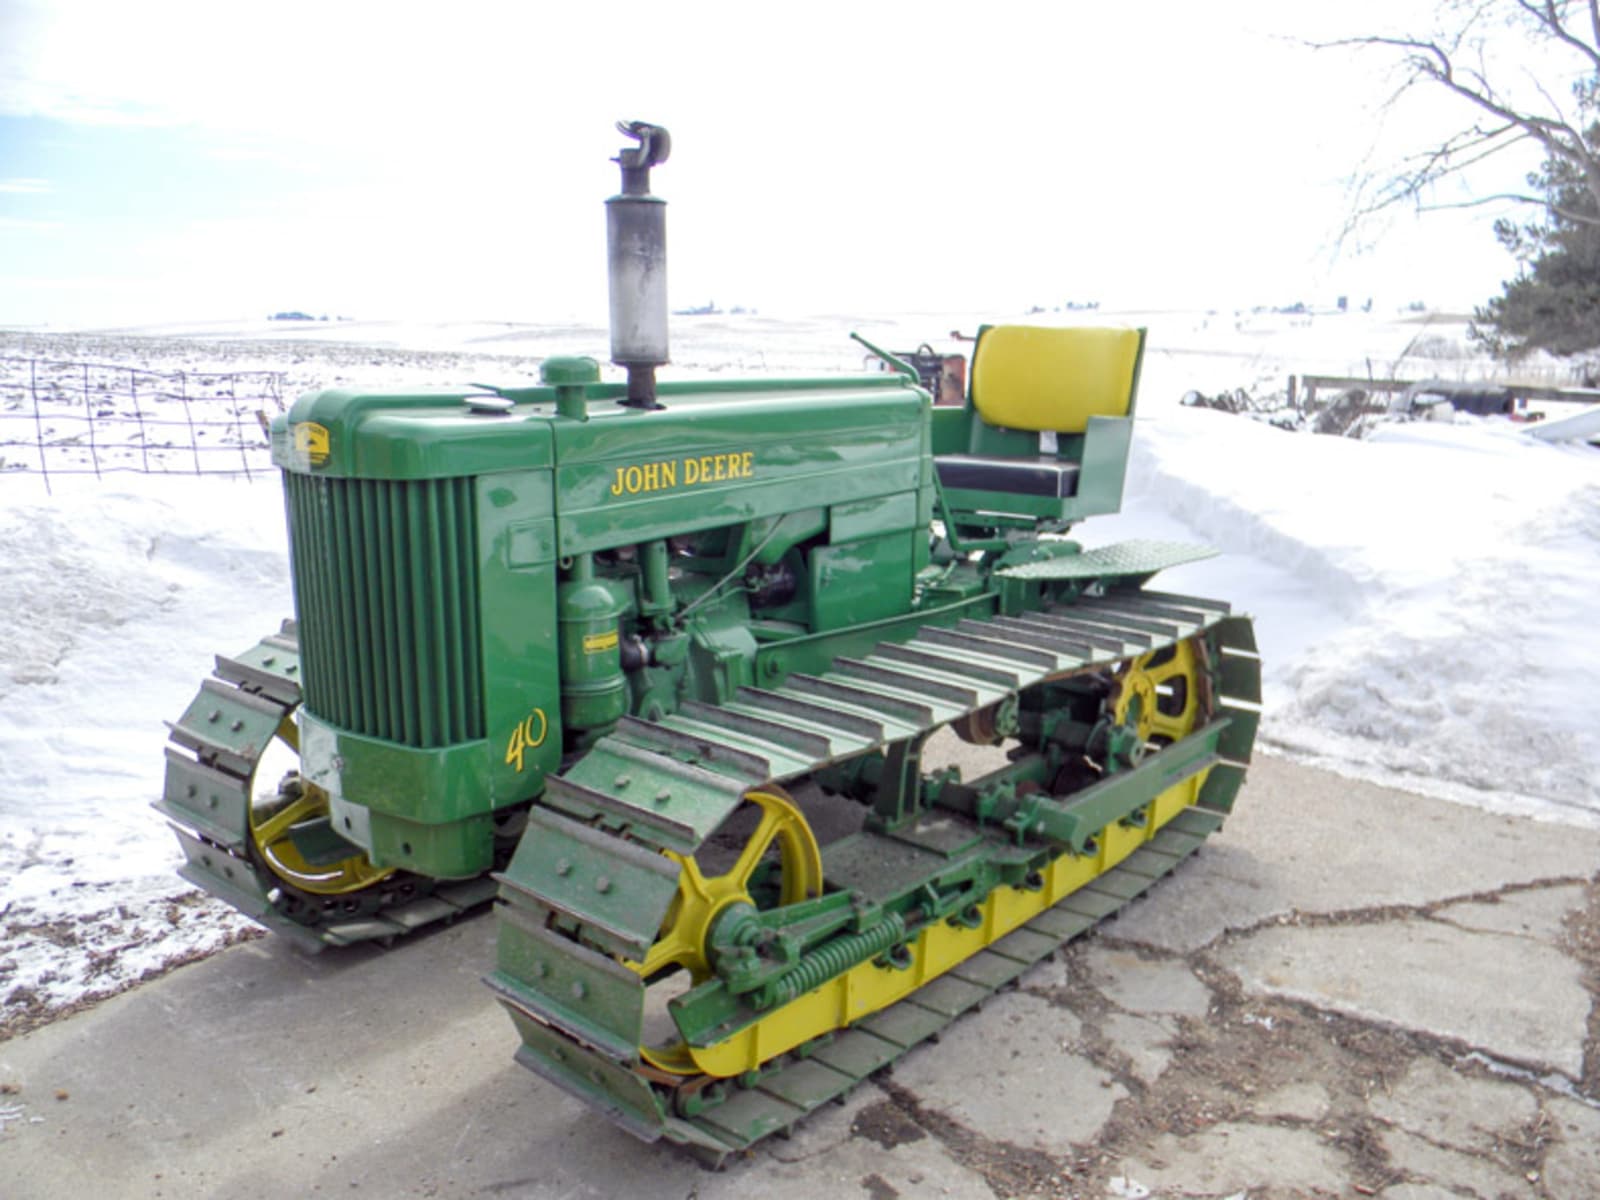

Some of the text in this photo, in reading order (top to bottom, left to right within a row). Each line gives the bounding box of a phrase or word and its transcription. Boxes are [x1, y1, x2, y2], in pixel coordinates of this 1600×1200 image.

[611, 452, 754, 496] JOHN DEERE
[505, 707, 547, 773] 40
